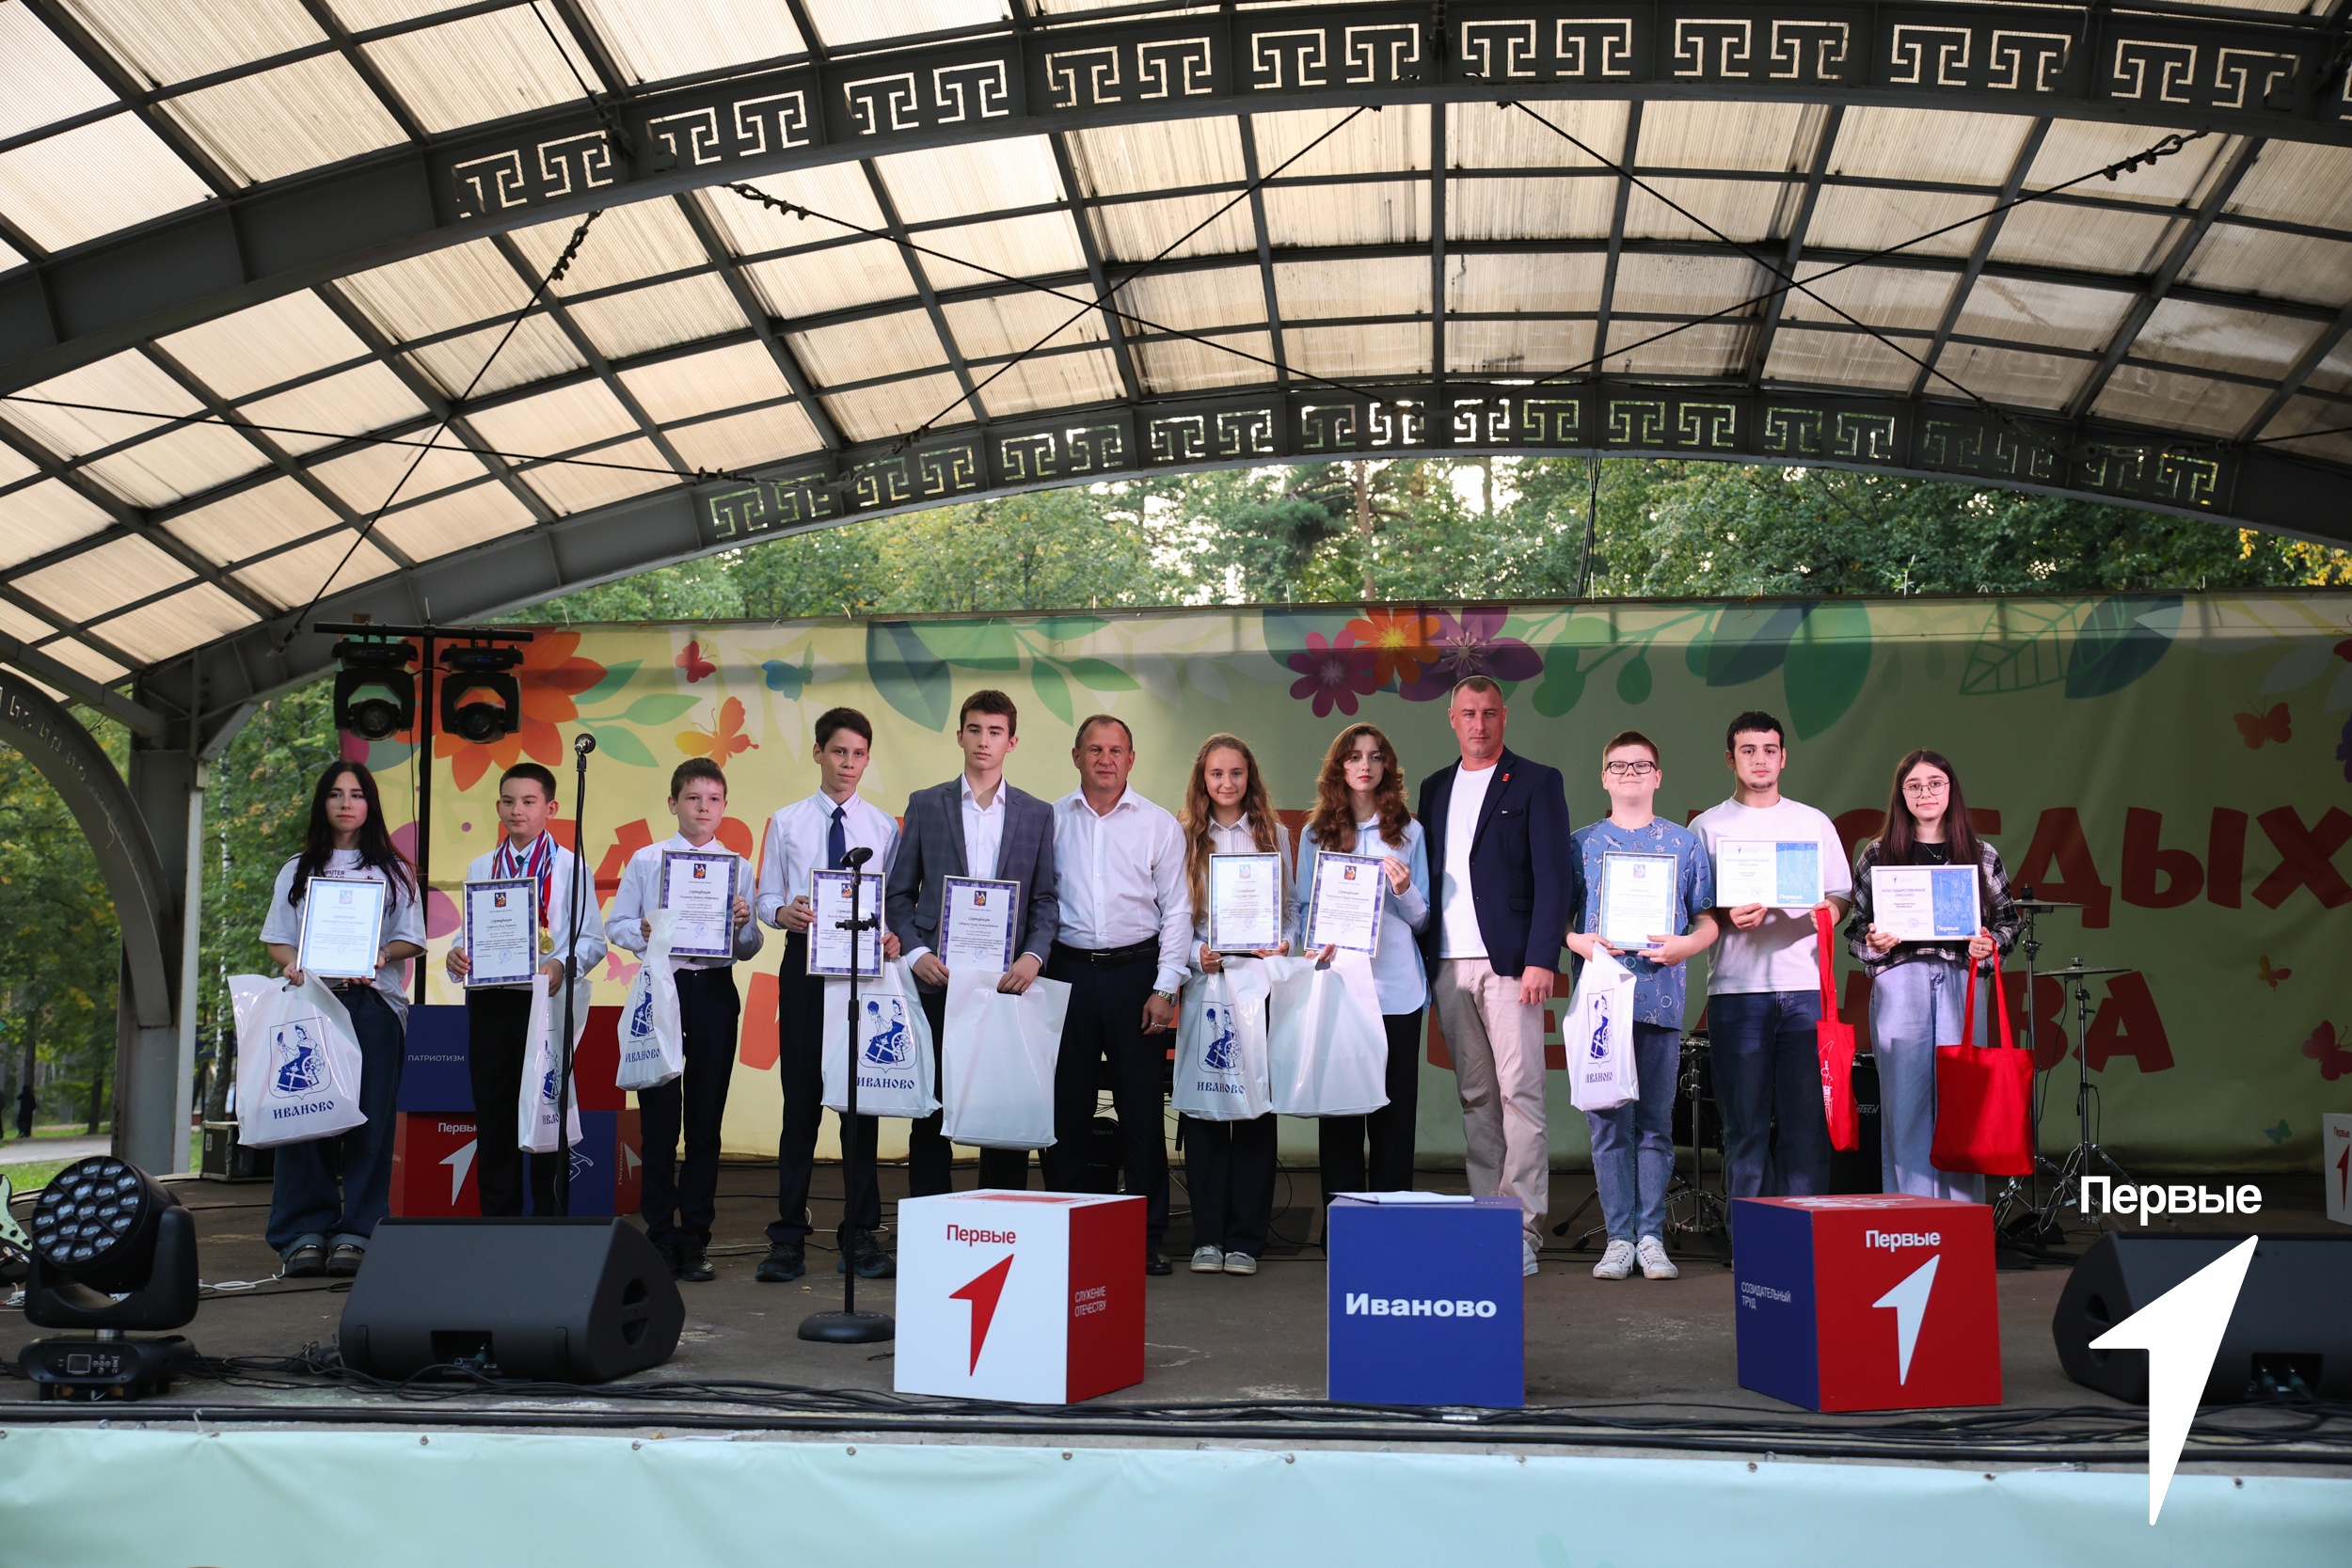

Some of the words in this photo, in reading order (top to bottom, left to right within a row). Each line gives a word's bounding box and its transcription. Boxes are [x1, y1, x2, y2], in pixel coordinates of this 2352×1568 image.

[625, 1048, 660, 1063] ИВАНОВО
[856, 1076, 915, 1089] ИВАНОВО
[1197, 1081, 1246, 1094] ИВАНОВО
[273, 1100, 335, 1119] ИВАНОВО
[437, 1122, 478, 1135] Первы
[946, 1224, 1016, 1247] Первые
[1865, 1229, 1941, 1253] Первые
[1074, 1285, 1106, 1303] СЛУЖЕНИЕ
[1740, 1281, 1791, 1303] СОЗИДАТЕЛЬНЫЙ
[1074, 1300, 1107, 1317] ОТЕЧЕСТВУ
[1345, 1292, 1497, 1319] Иваново
[1741, 1295, 1756, 1310] ТРУД
